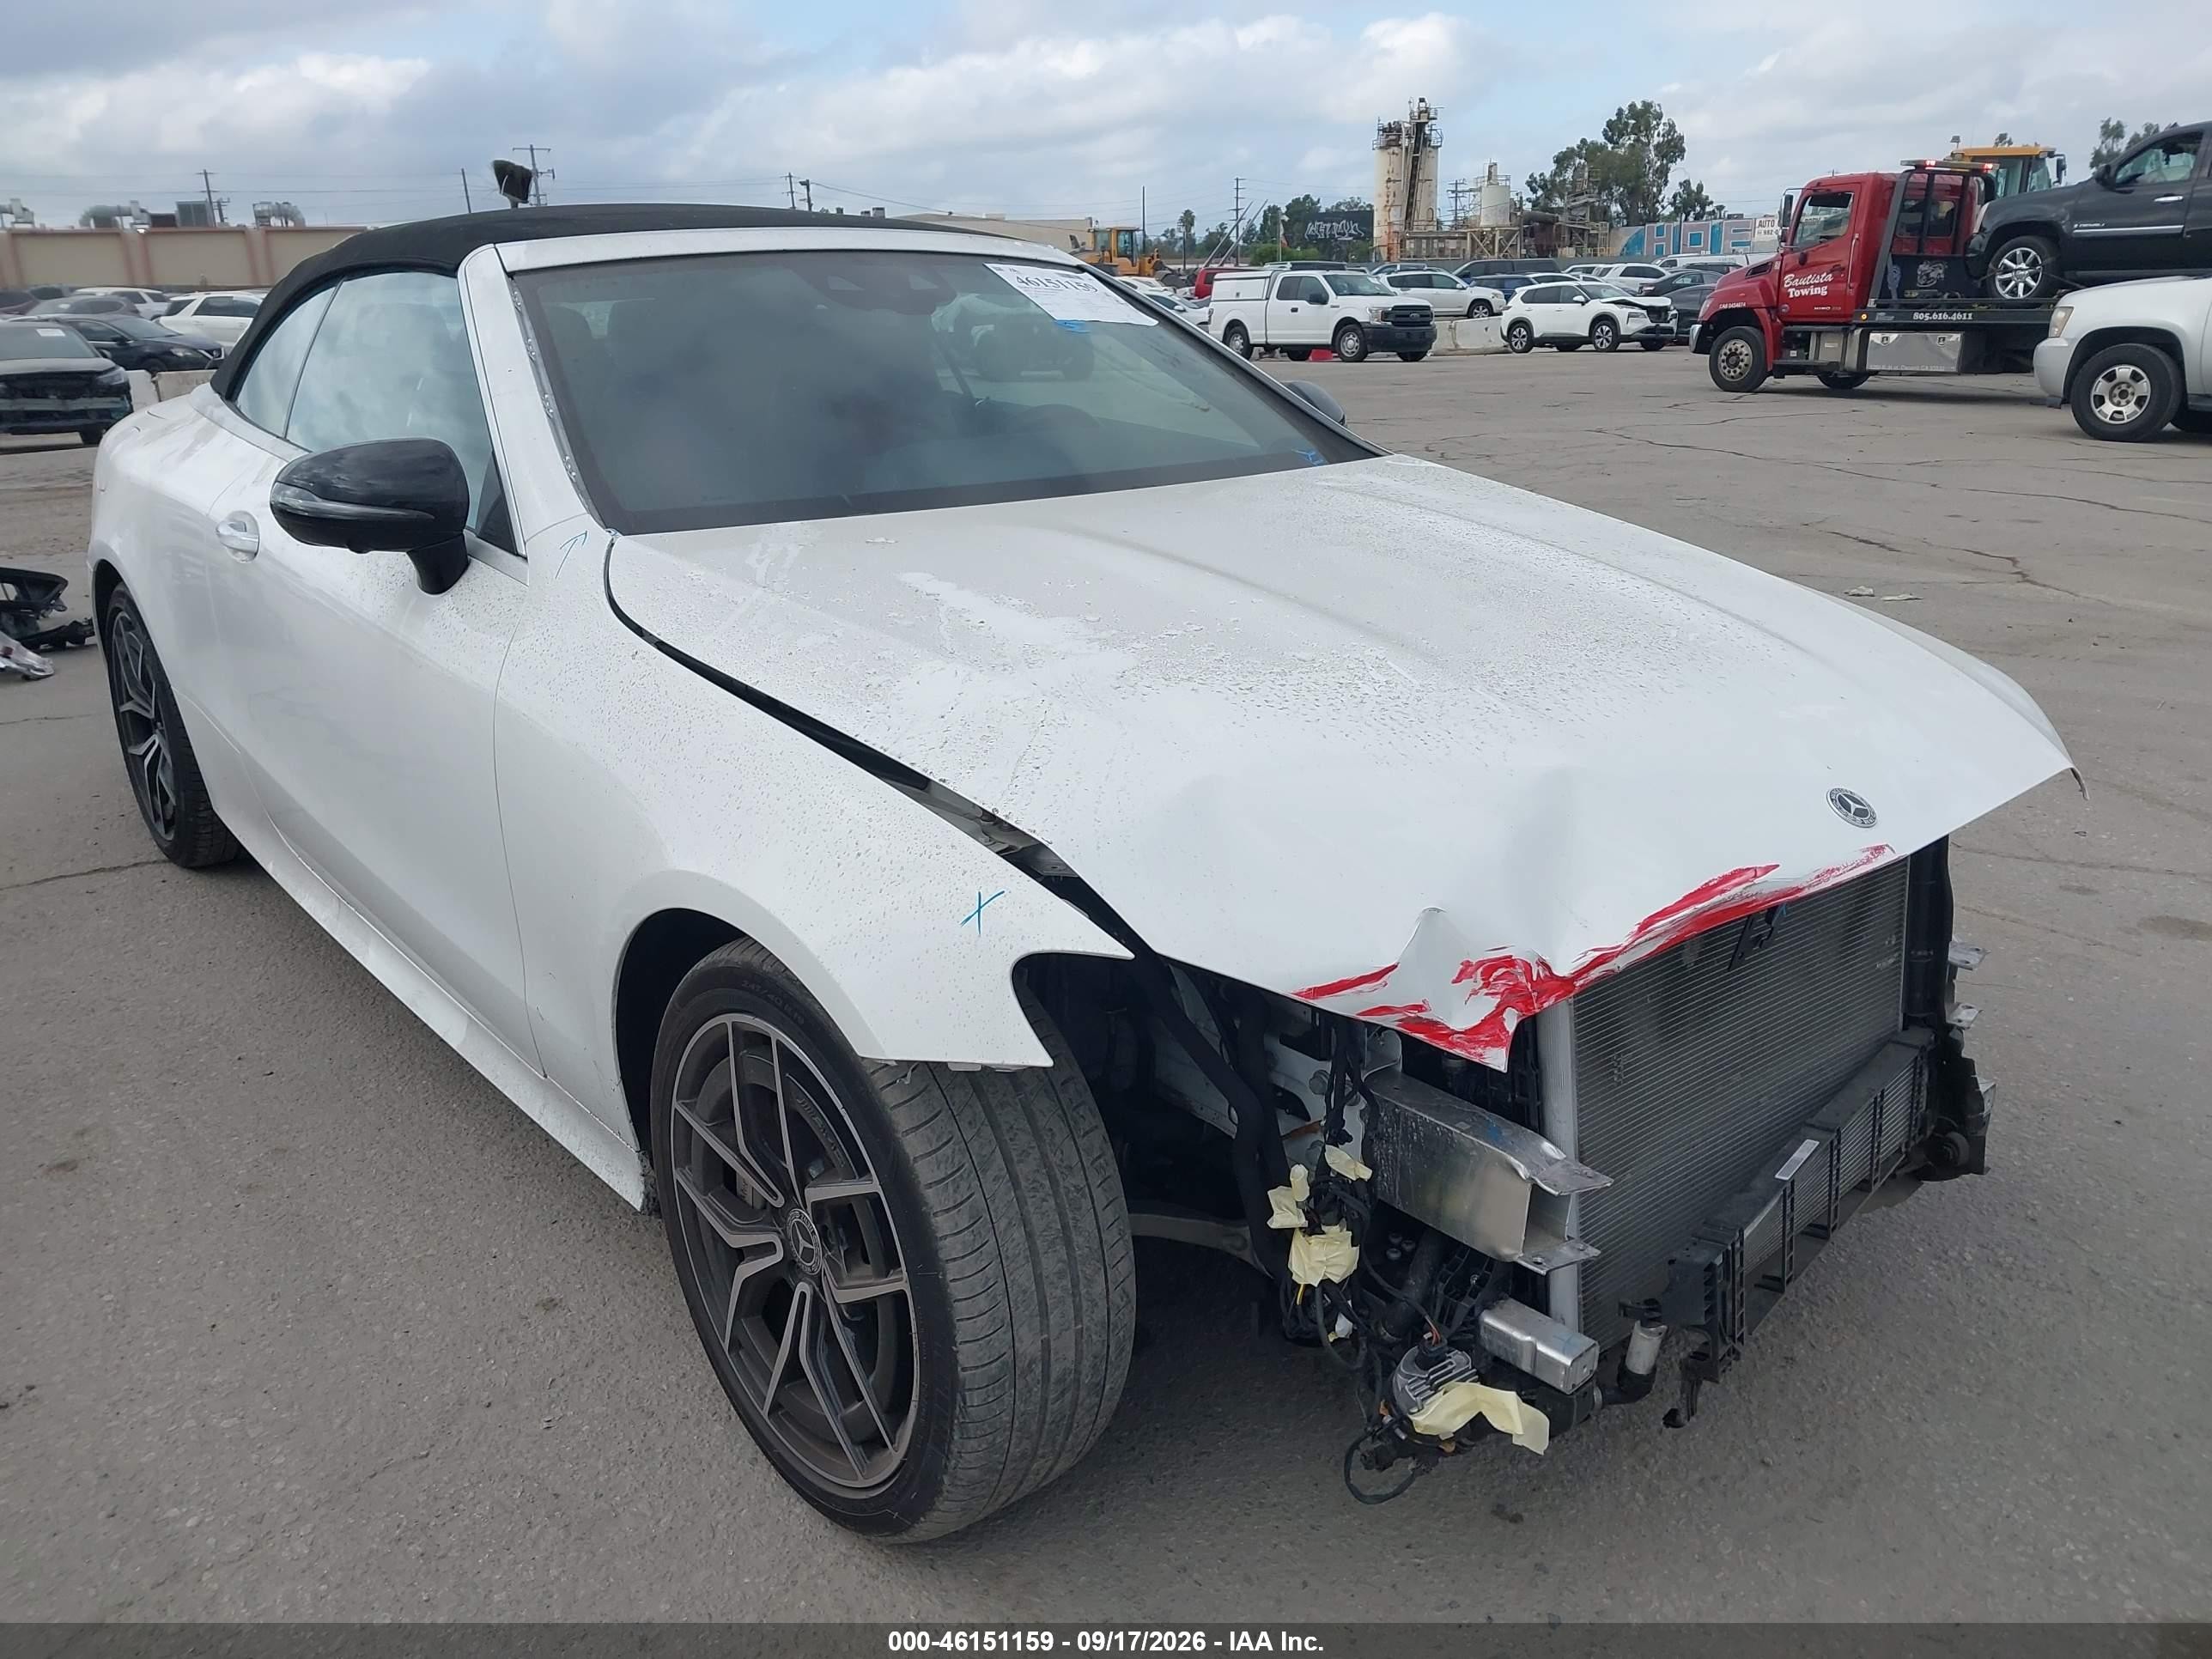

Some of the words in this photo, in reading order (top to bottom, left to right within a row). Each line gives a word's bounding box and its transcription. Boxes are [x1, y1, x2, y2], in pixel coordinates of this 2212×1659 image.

[1758, 219, 1775, 228] AUTO
[1015, 275, 1099, 293] 46151159
[1784, 272, 1834, 288] Bautista
[1787, 285, 1828, 298] Towing
[1912, 312, 1973, 321] 805.616.4611
